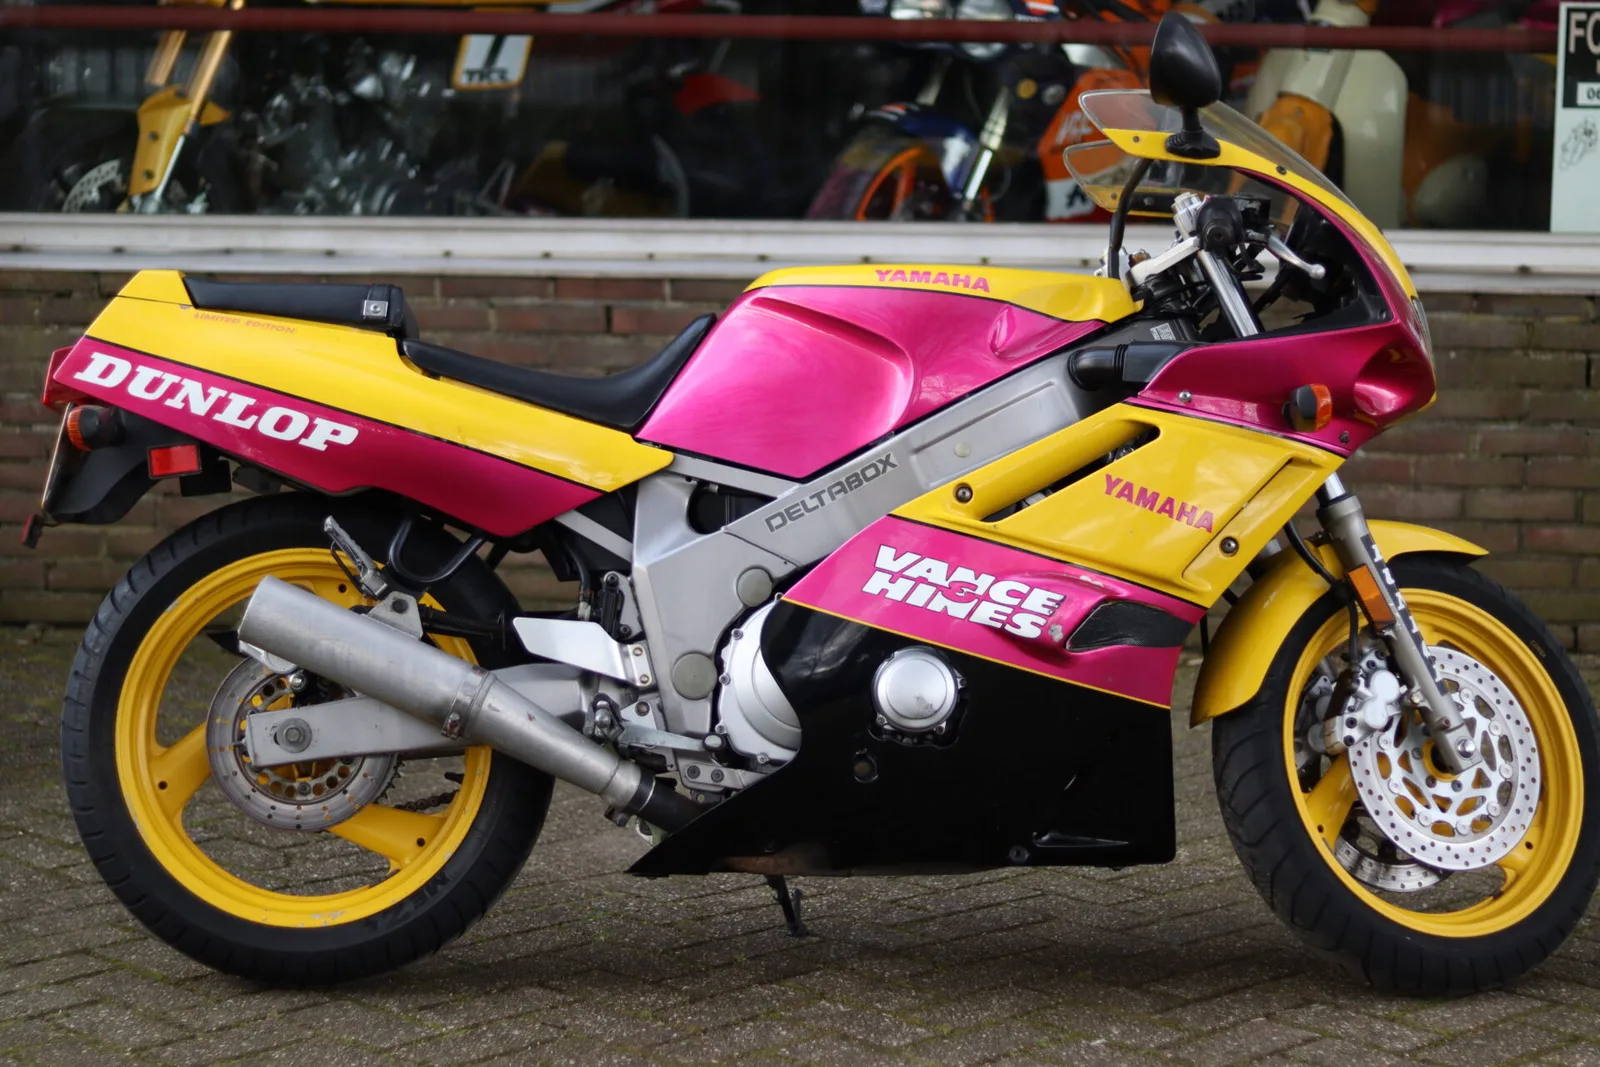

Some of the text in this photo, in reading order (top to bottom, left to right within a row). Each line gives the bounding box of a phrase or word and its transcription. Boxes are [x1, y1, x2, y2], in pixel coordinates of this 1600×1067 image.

[875, 269, 990, 293] YAMAHA
[193, 312, 295, 334] LIMITED EDITION
[74, 351, 359, 451] DUNLOP
[764, 452, 898, 533] DELTABOX
[1104, 473, 1214, 533] YAMAHA
[861, 570, 1049, 639] HINES
[874, 544, 1066, 616] VANCE
